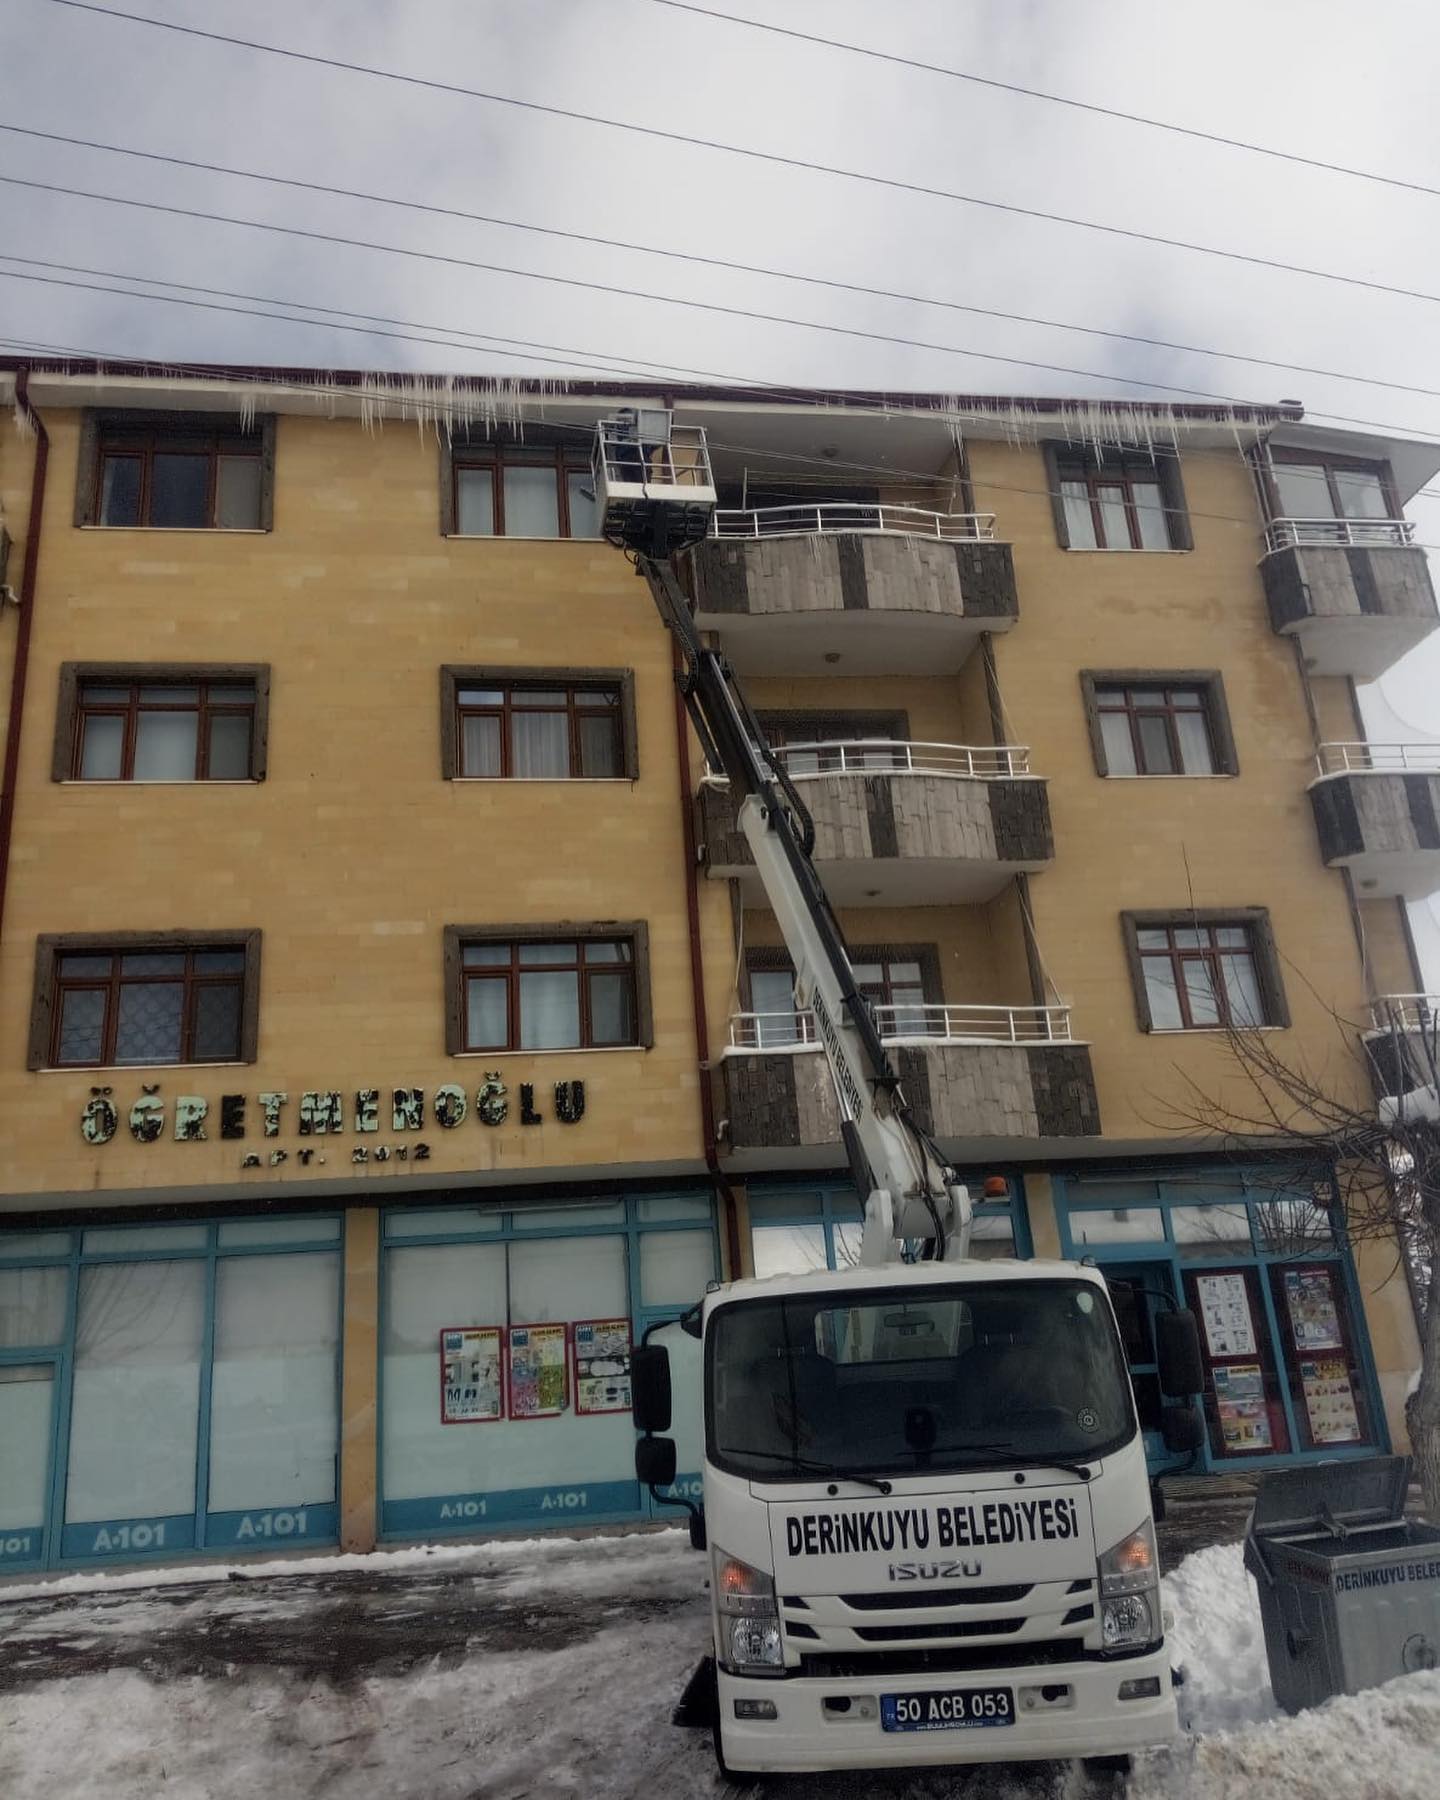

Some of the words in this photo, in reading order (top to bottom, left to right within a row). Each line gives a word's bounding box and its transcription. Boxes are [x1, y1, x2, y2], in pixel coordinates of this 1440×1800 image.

[81, 1071, 586, 1145] ÖĞRETMENOĞLU
[352, 1143, 430, 1164] 2012
[888, 1558, 982, 1581] ISUZU
[896, 1698, 921, 1722] 50
[928, 1696, 965, 1719] ACB
[971, 1693, 1009, 1717] 053
